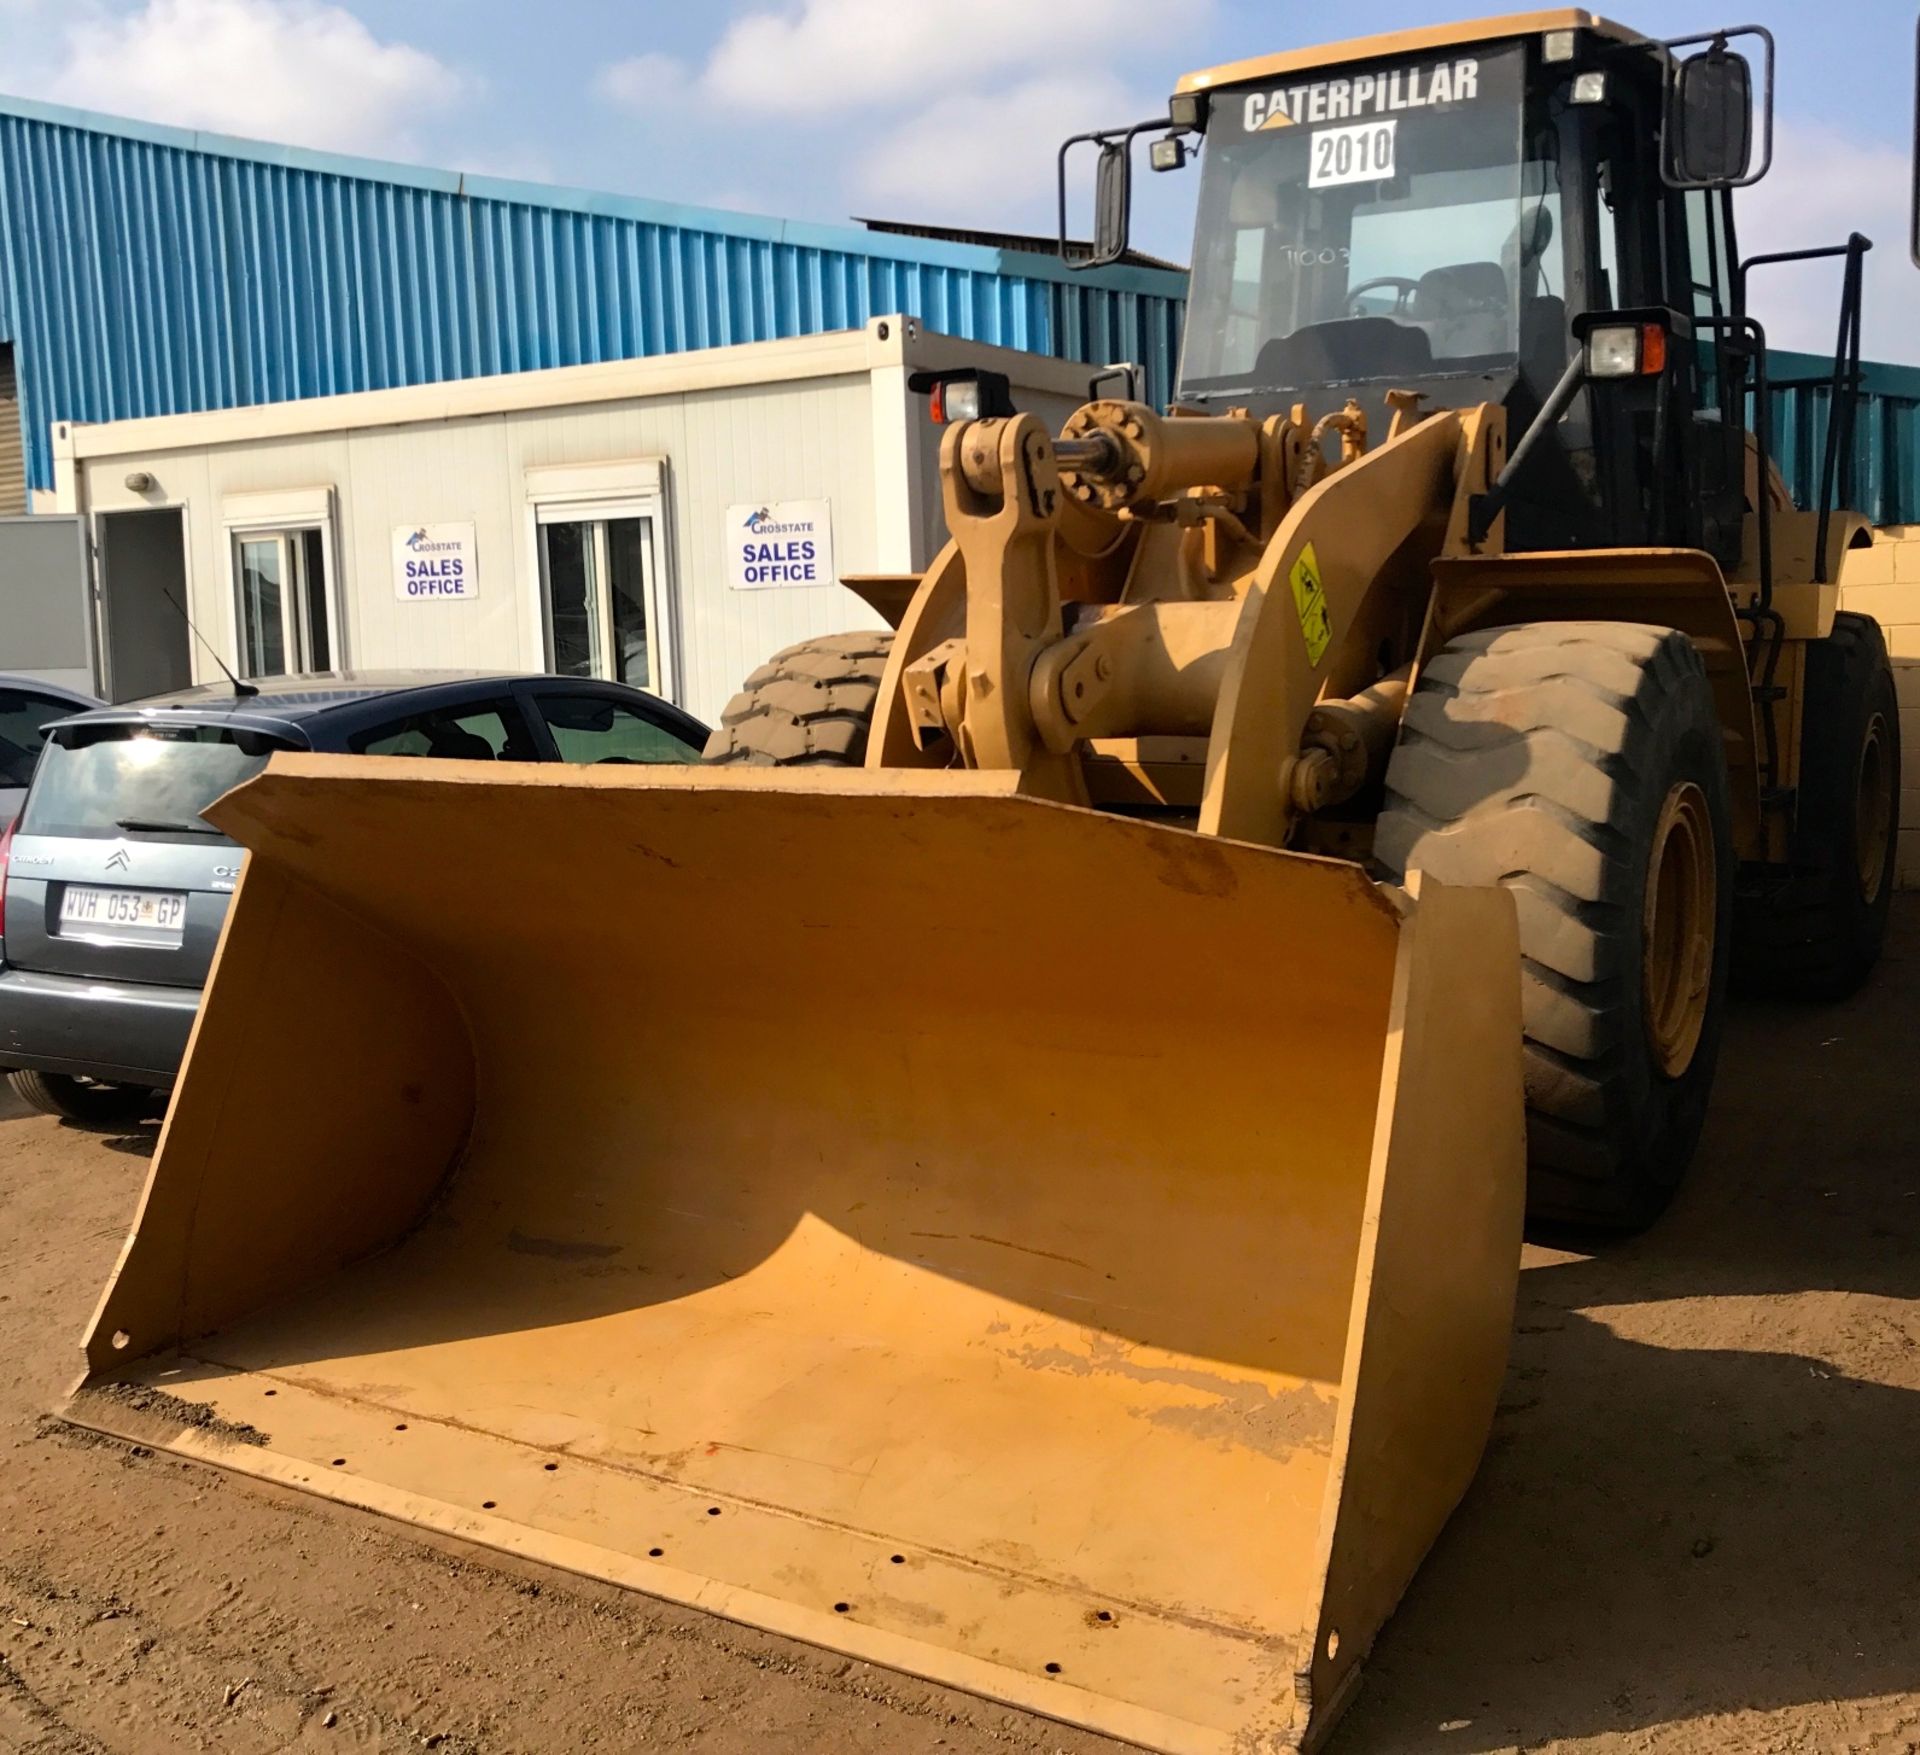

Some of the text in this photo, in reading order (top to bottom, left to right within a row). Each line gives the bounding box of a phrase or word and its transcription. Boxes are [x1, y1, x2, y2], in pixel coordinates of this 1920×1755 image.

[1243, 58, 1478, 133] CATERPILLAR
[1316, 128, 1392, 179] 2010
[751, 521, 814, 534] CROSSTATE
[411, 541, 462, 552] CROSSTATE
[743, 541, 815, 563] SALES
[406, 558, 463, 578] SALES
[744, 564, 816, 583] OFFICE
[407, 578, 465, 596] OFFICE
[66, 890, 181, 925] WVH 053 GP
